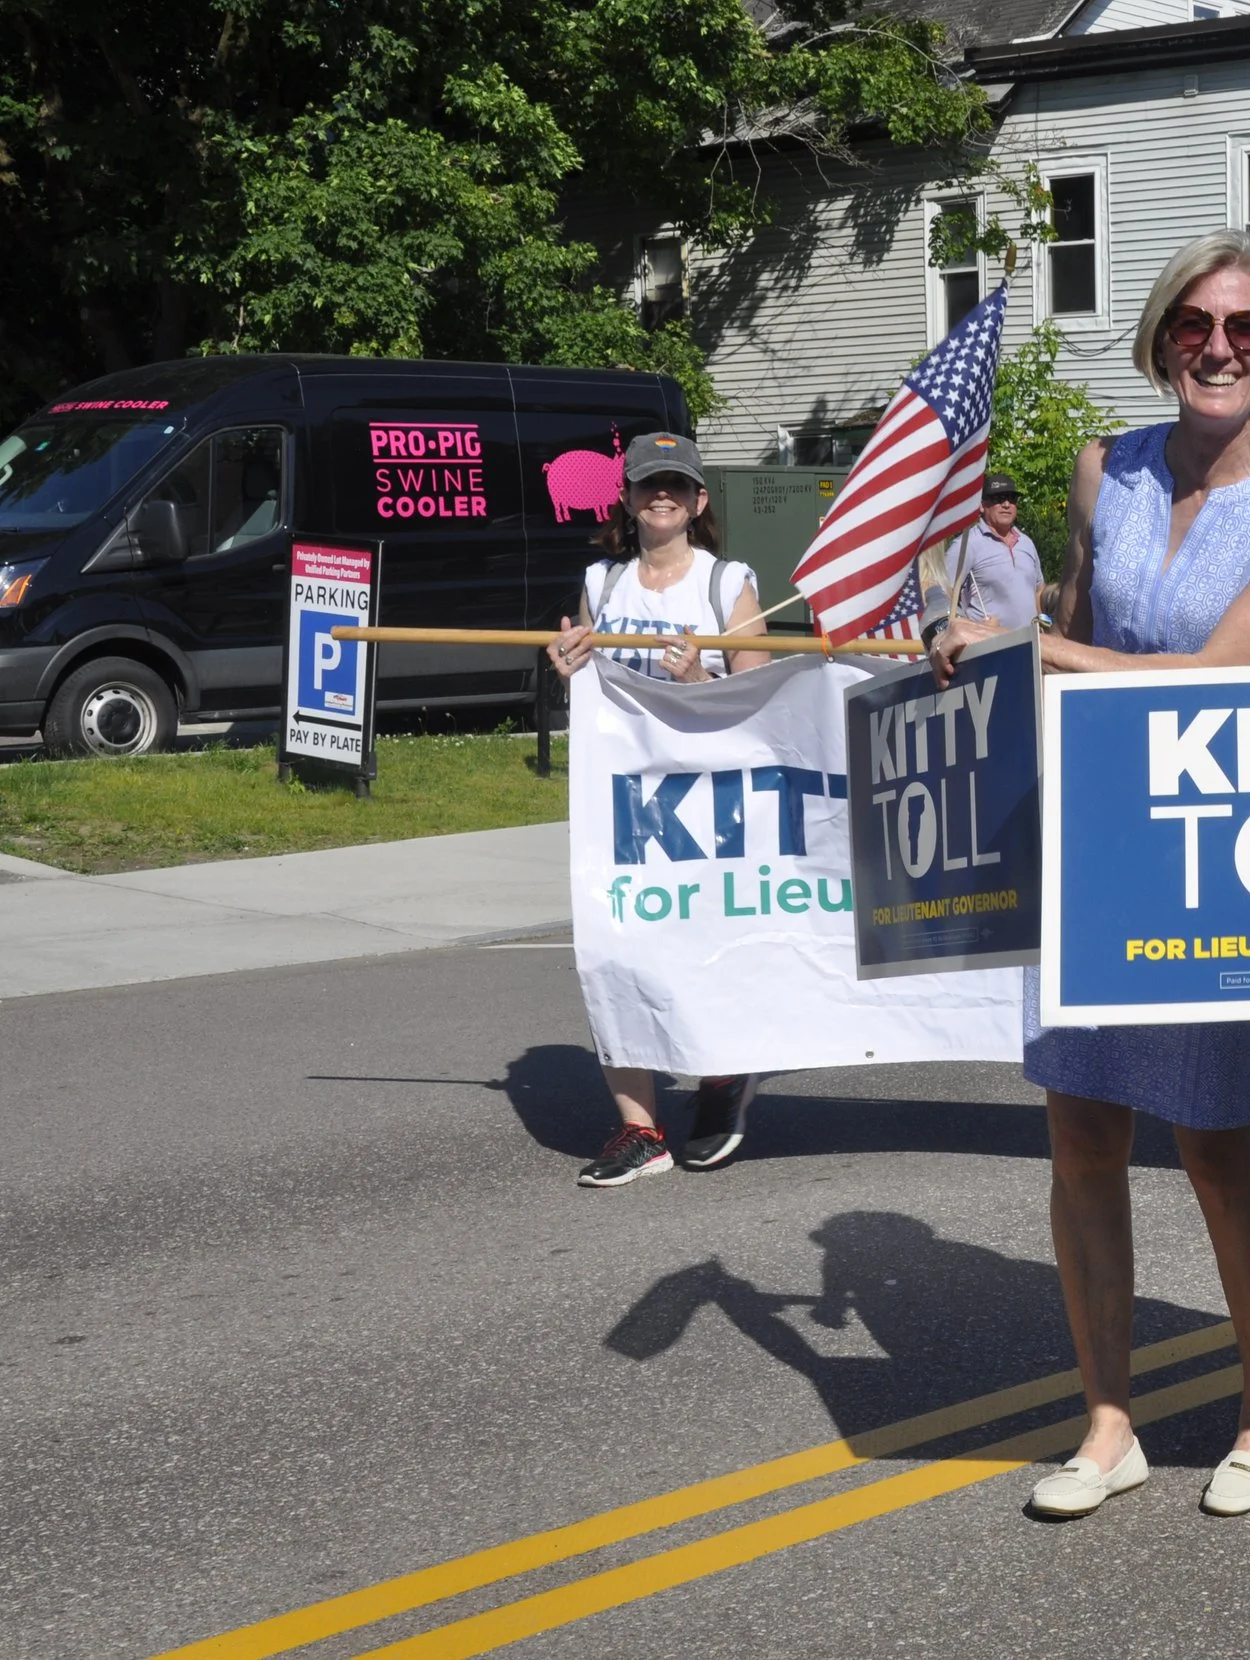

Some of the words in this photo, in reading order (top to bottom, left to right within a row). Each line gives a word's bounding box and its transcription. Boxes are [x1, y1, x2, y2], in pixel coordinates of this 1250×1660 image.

[75, 400, 115, 410] SWINE
[114, 400, 169, 409] COOLER
[376, 469, 484, 492] SWINE
[377, 496, 487, 518] COOLER
[297, 551, 317, 564] Privately
[317, 553, 333, 564] Owned
[341, 556, 363, 568] Managed
[364, 558, 370, 570] by
[322, 566, 340, 579] Parking
[341, 567, 360, 579] Partners
[295, 583, 369, 611] PARKING
[314, 632, 342, 690] P
[290, 728, 309, 744] PAY
[313, 732, 327, 748] BY
[330, 736, 361, 753] PLATE
[870, 676, 999, 784] KITTY
[612, 765, 848, 866] KIT
[873, 772, 1001, 881] TOLL
[608, 875, 701, 924] for
[724, 864, 854, 918] Lieu
[873, 907, 892, 926] FOR
[892, 899, 951, 924] LIEUTENANT
[952, 889, 1018, 916] GOVERNOR
[1126, 936, 1187, 961] FOR
[1226, 976, 1242, 985] Paid
